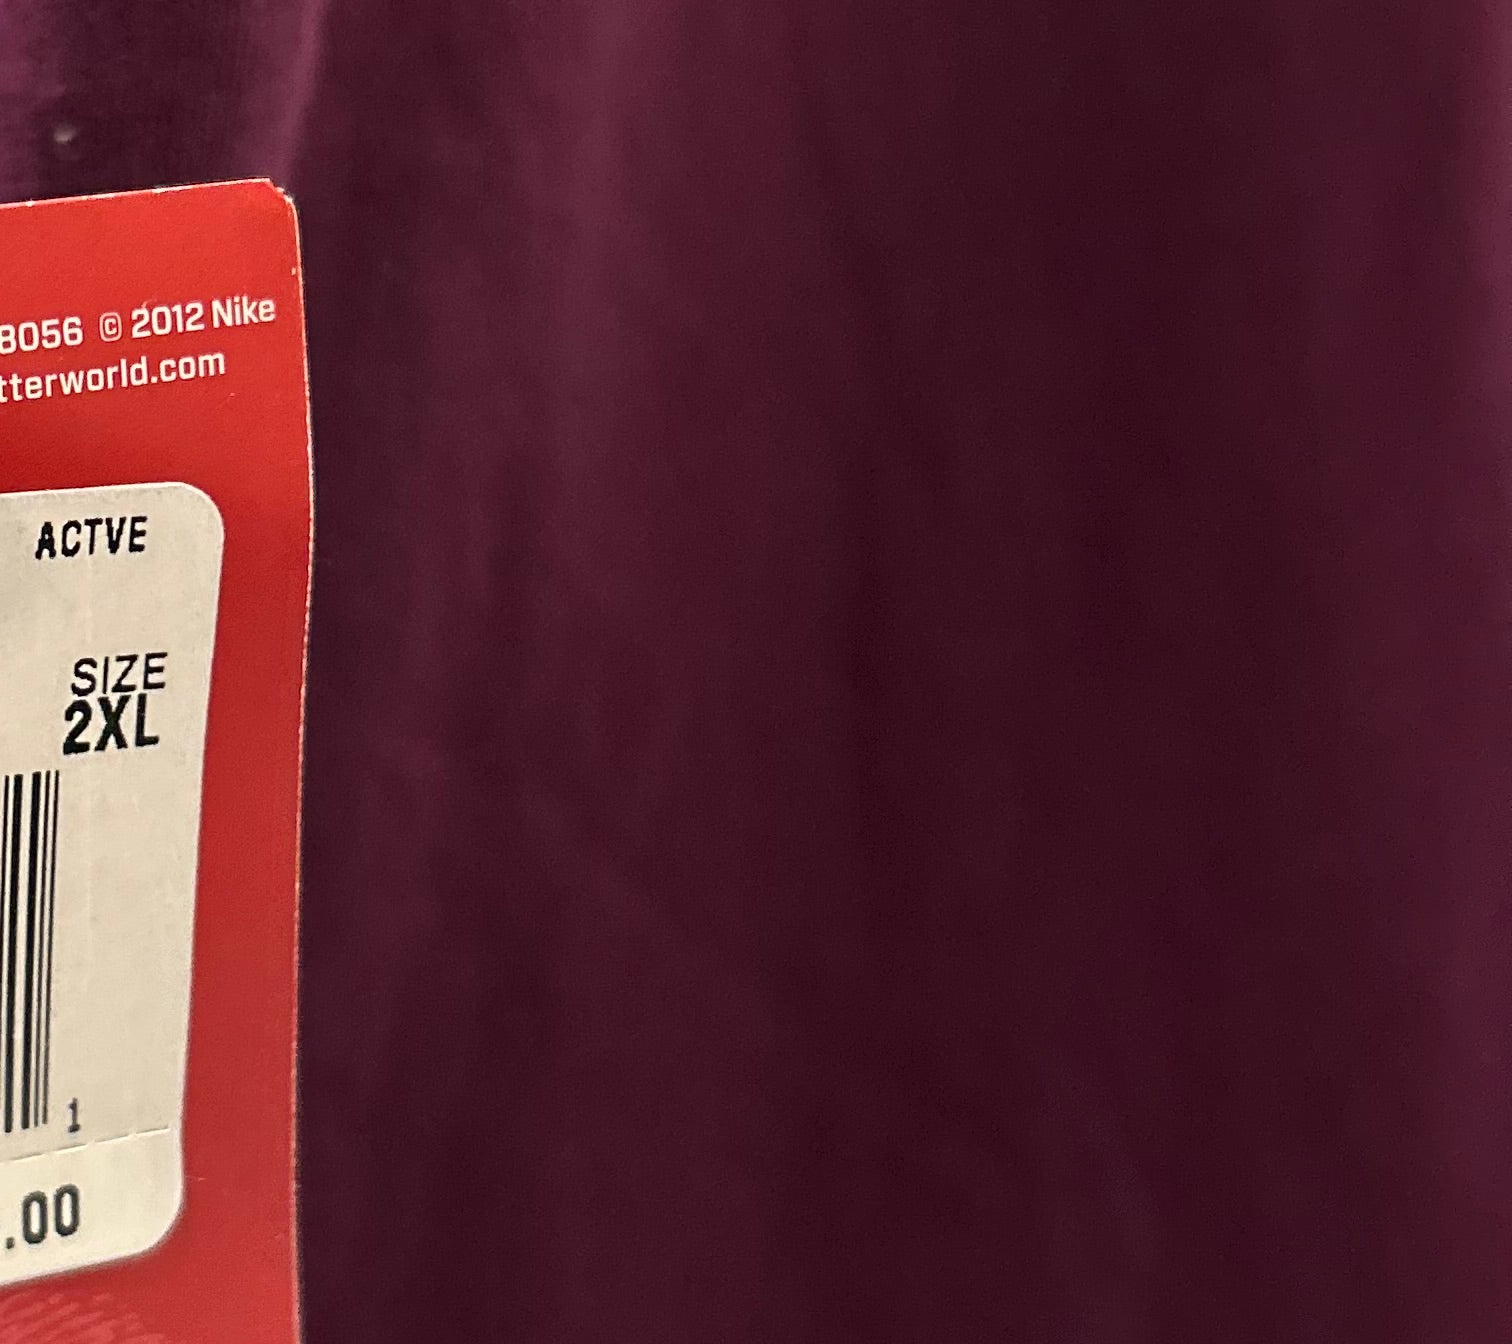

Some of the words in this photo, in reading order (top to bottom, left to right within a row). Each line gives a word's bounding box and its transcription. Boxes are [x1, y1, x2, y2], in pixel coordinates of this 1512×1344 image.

[131, 302, 206, 339] 2012
[212, 296, 276, 330] Nike
[35, 515, 148, 560] ACTVE
[71, 652, 168, 699] SIZE
[62, 696, 160, 756] 2XL
[67, 1098, 82, 1133] 1
